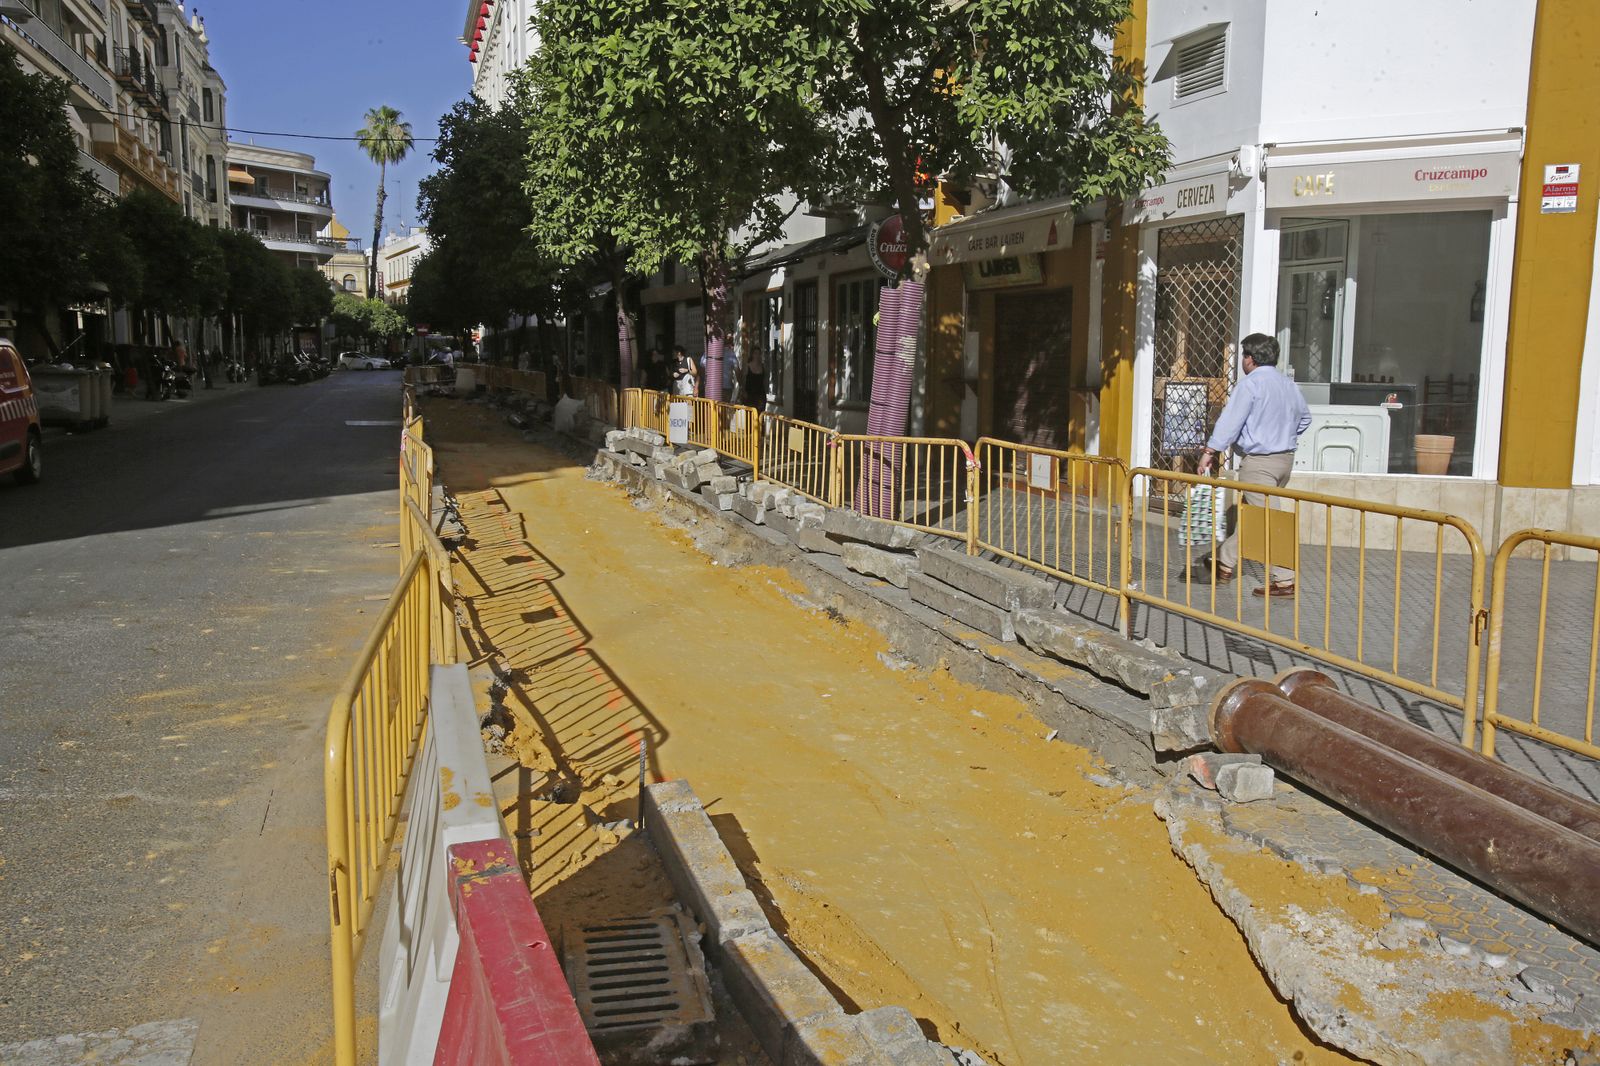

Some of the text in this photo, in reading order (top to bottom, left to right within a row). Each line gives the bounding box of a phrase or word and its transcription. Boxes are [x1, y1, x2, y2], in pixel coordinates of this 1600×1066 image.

[1414, 168, 1488, 182] Cruzcampo
[1293, 170, 1336, 197] CAFÉ
[1545, 185, 1577, 193] Alarma
[1177, 184, 1215, 209] CERVEZA
[985, 236, 999, 249] BAR
